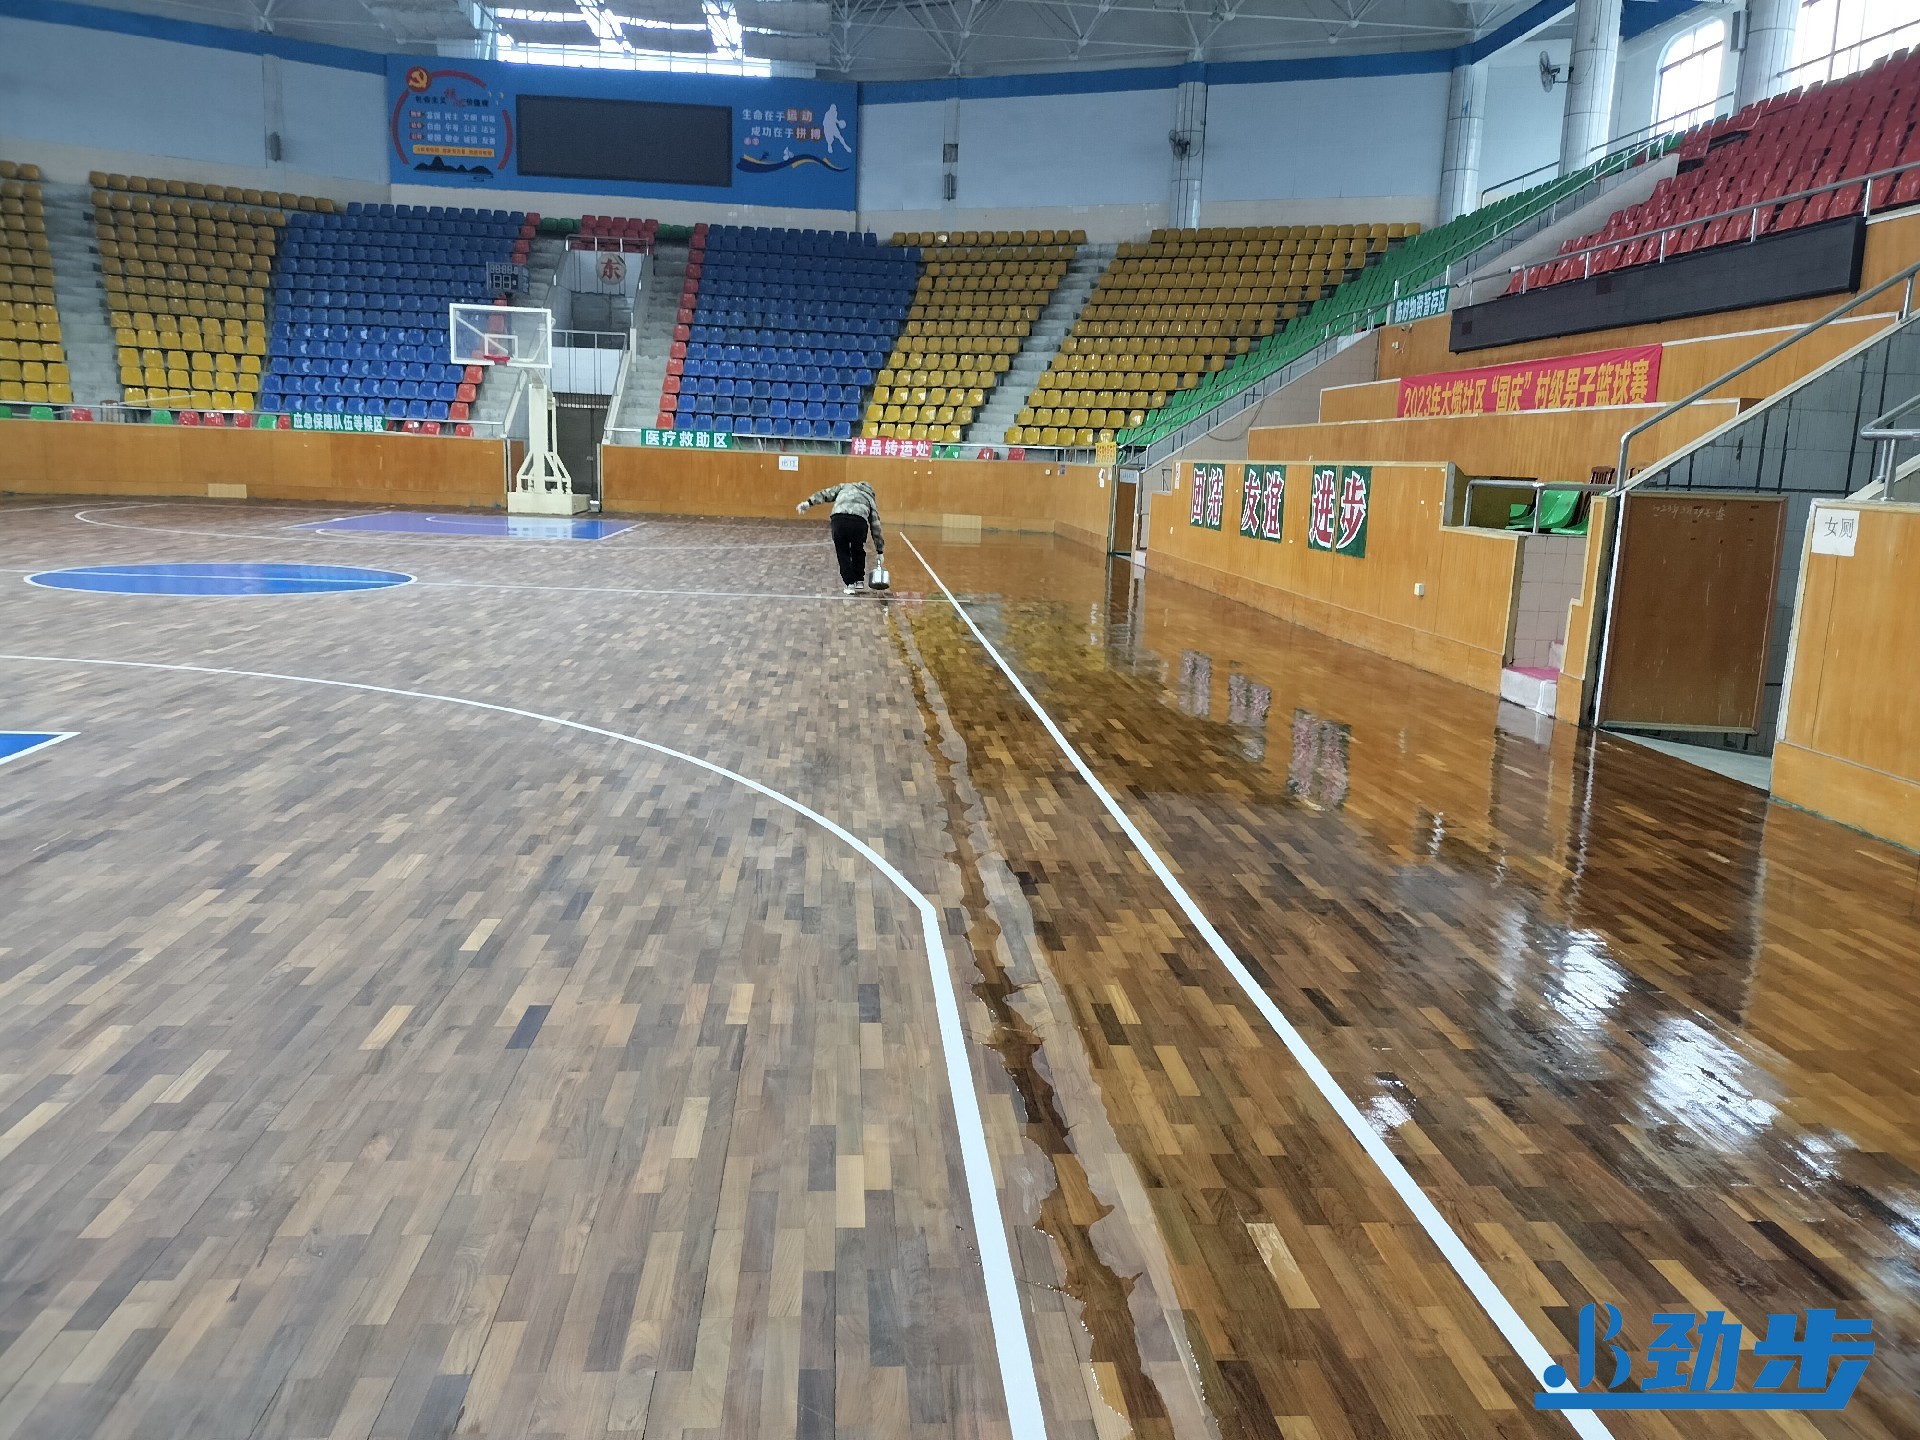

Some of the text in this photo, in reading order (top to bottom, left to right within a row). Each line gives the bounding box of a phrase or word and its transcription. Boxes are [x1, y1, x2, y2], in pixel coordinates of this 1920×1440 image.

[742, 108, 814, 123] 生命在于运动
[751, 126, 821, 140] 成功在于拼搏
[601, 258, 621, 281] 东
[293, 412, 384, 433] 应急保障队伍等候区
[645, 430, 728, 448] 医疗救助区
[854, 438, 930, 457] 样品转运处
[1190, 466, 1367, 550] 团结 友谊 进步
[1824, 516, 1855, 539] 女厕
